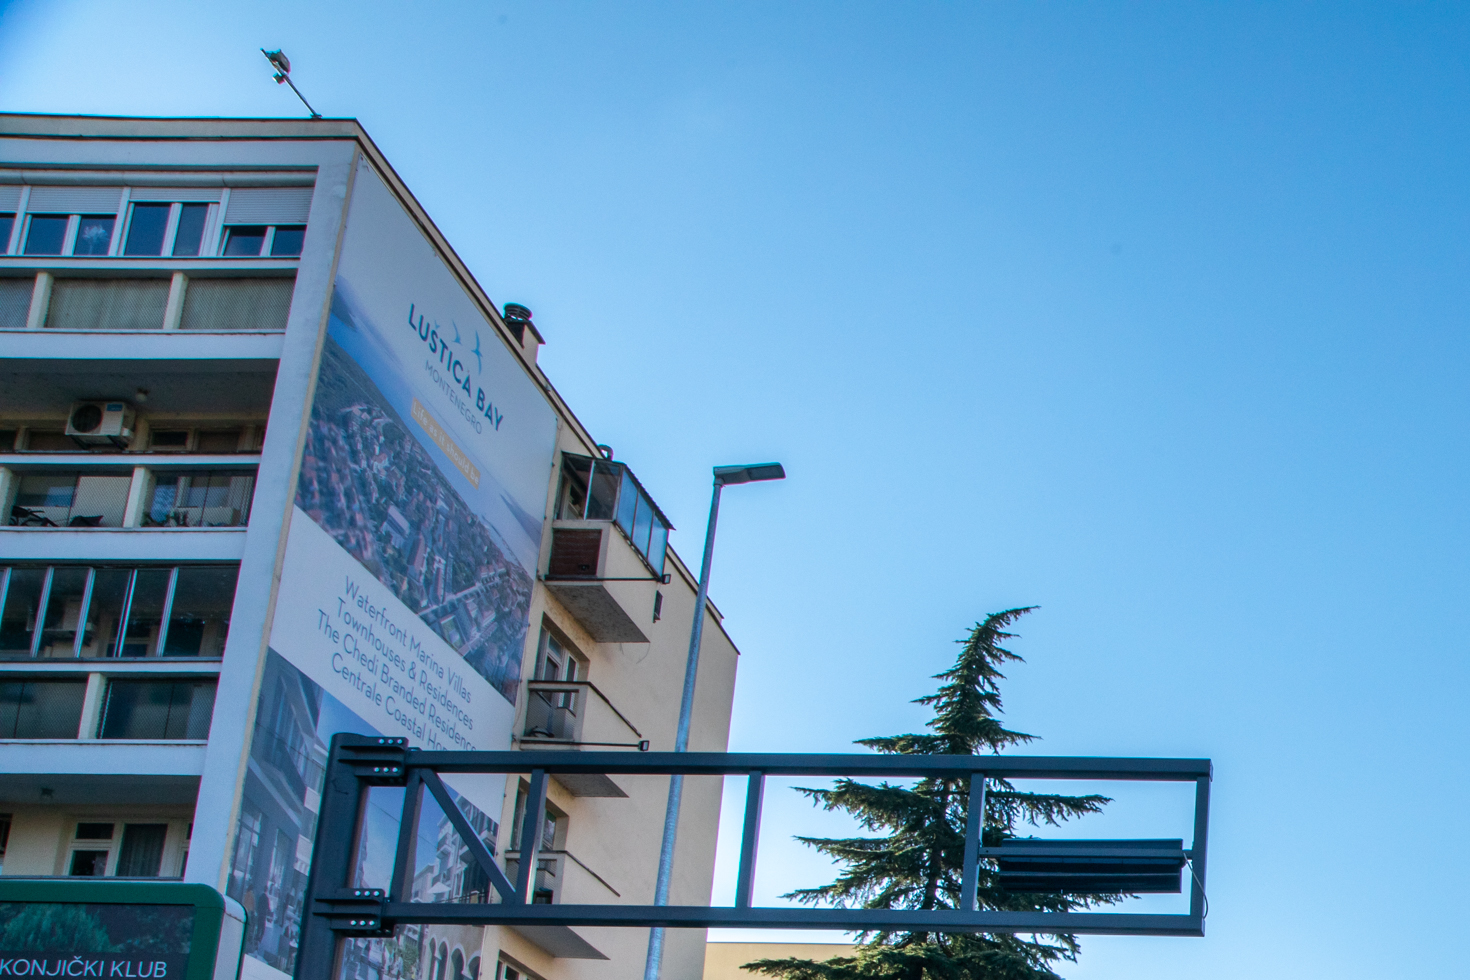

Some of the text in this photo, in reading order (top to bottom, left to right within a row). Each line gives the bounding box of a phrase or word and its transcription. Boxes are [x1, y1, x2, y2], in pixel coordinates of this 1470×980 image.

[425, 360, 483, 434] MONTENEGRO
[476, 387, 504, 432] BAY
[412, 402, 480, 485] Life as it should be
[318, 609, 340, 644] The
[343, 633, 379, 677] Chedi
[380, 663, 427, 715] Branded
[337, 597, 474, 731] Townhouses & Residences
[345, 575, 472, 704] Waterfront Marina Villas
[331, 652, 382, 706] Centrale
[385, 696, 427, 742] Coastal
[0, 955, 167, 979] KONJIČKI KLUB
